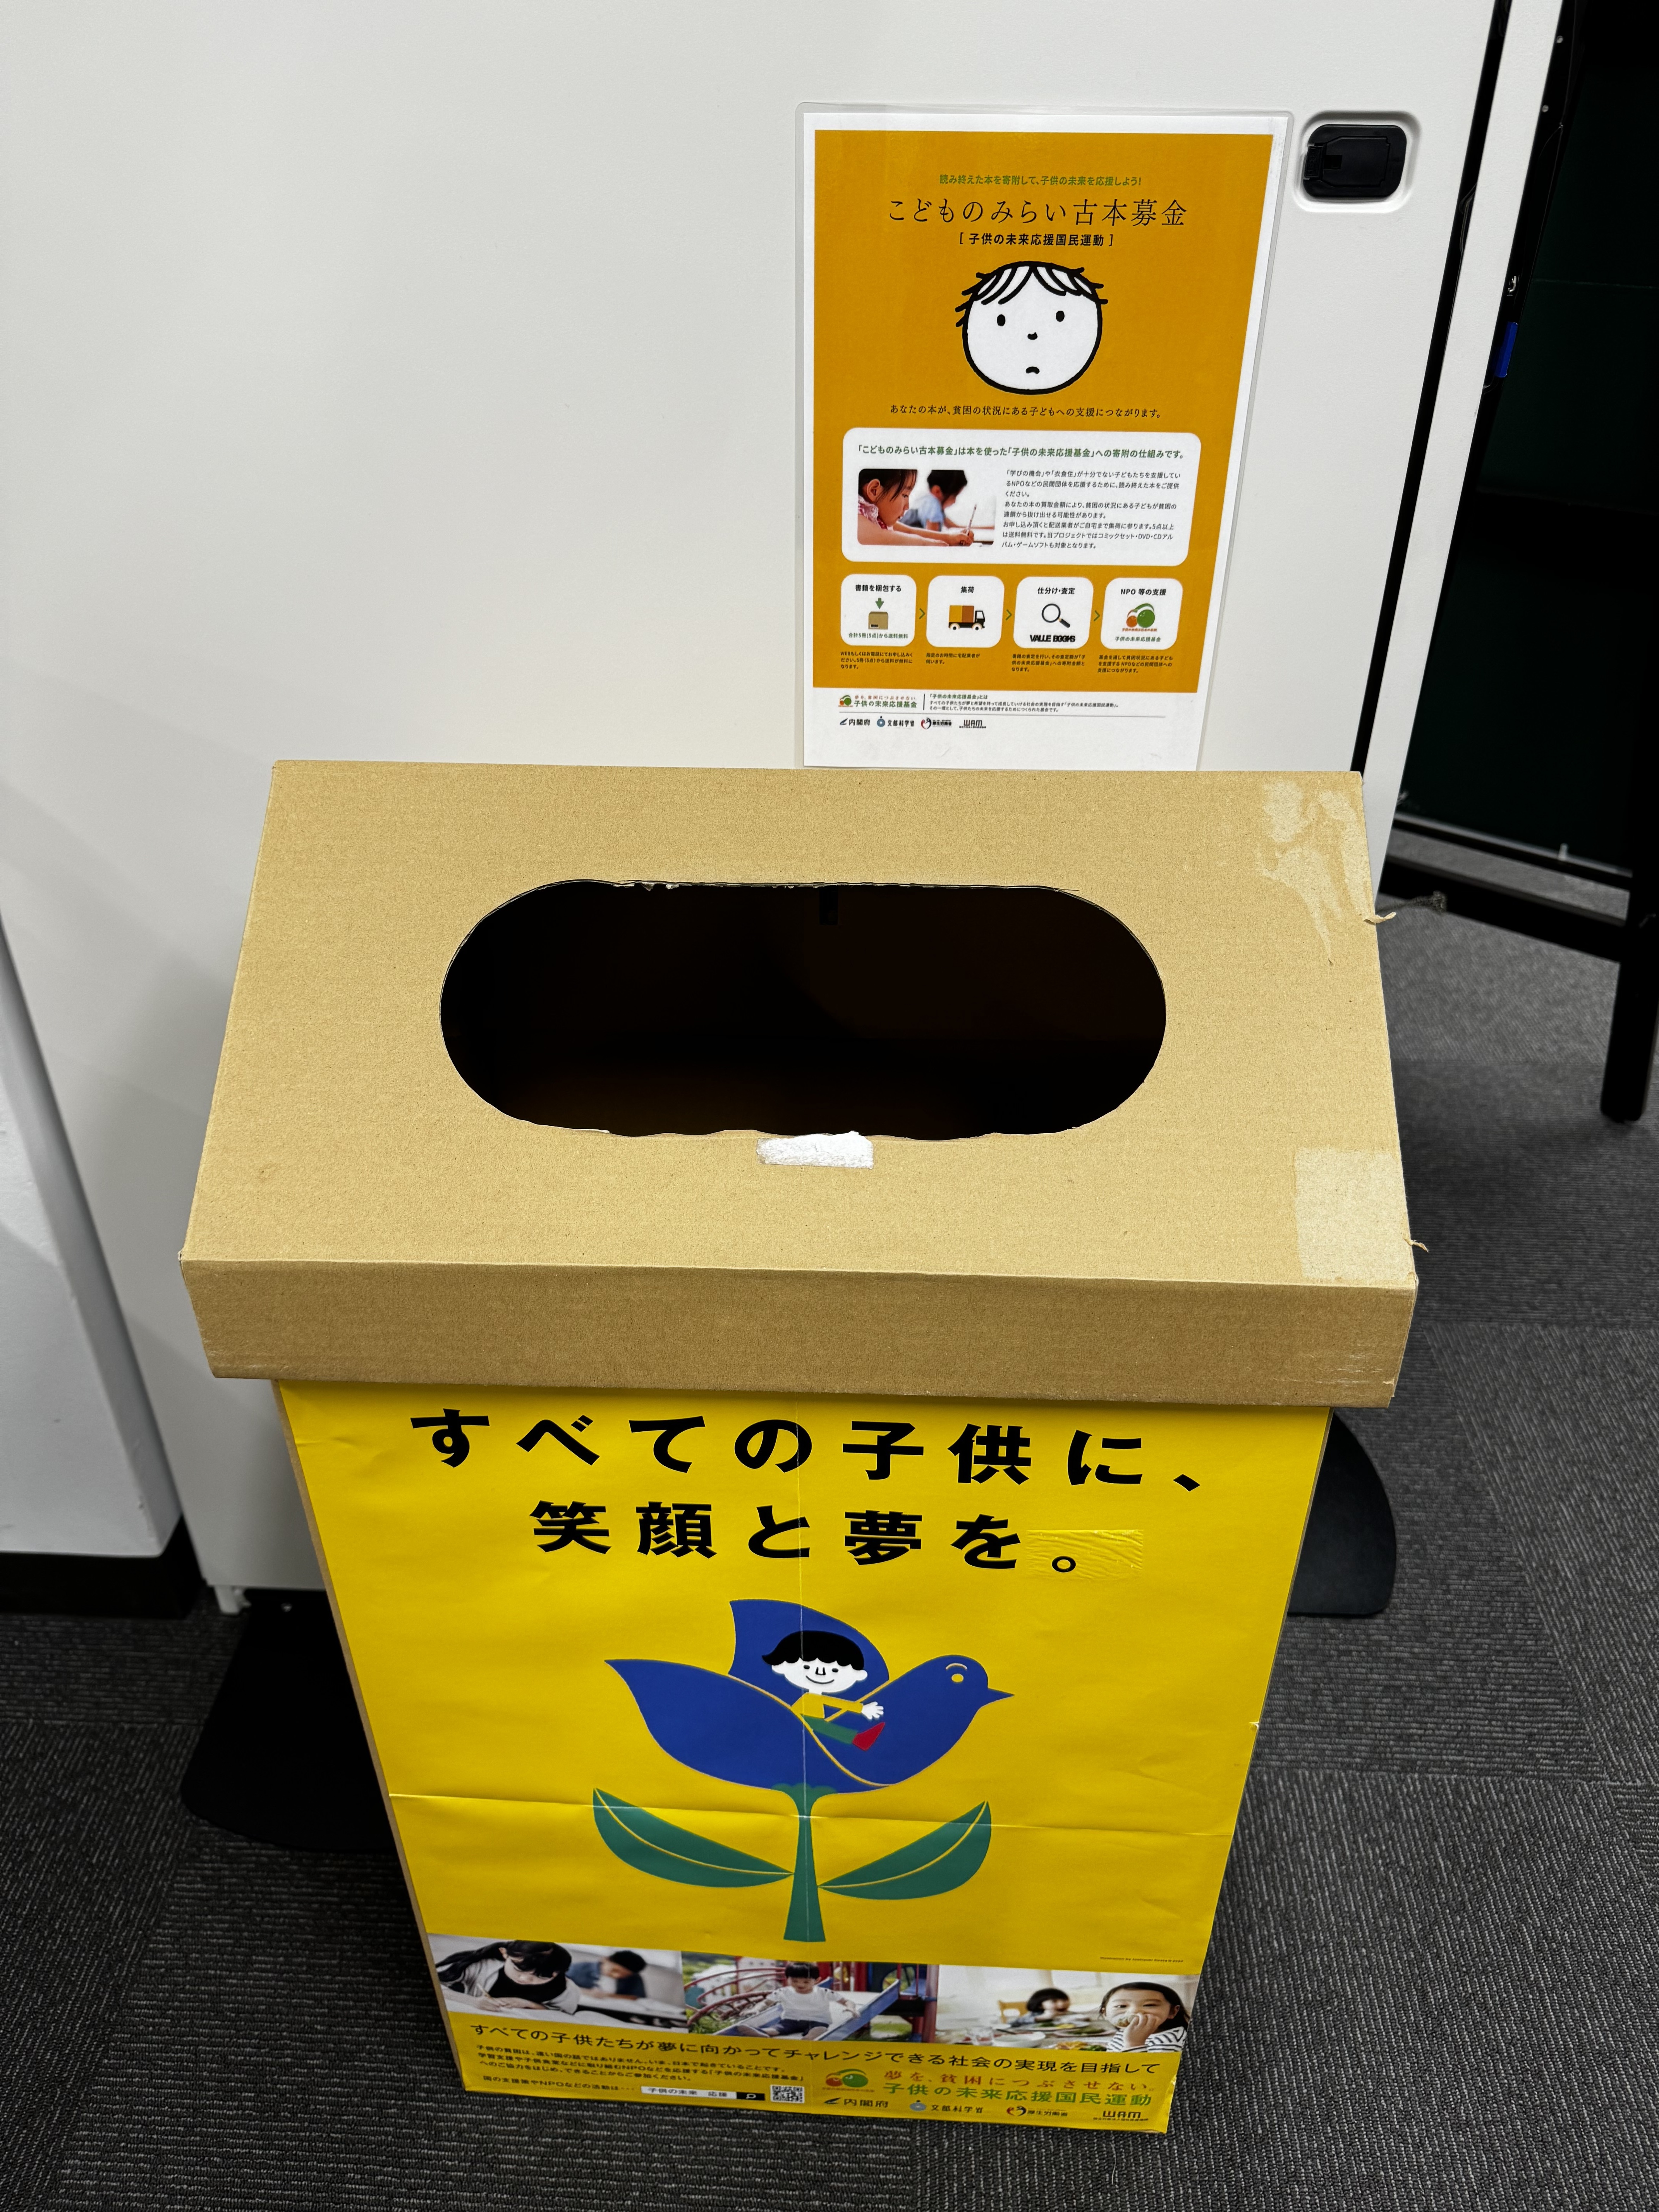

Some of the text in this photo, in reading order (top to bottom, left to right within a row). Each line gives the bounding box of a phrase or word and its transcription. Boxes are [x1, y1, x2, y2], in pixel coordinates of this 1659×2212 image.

[888, 198, 1187, 226] こどものみらい古本募金
[890, 404, 1161, 419] あなたの本が、貧困の状況にある子どもへの支援につながります。
[859, 445, 1183, 459] 「こどものみらい古本募金」は本を使った「子供の未来応援基金」への寄附の仕組みです。
[854, 700, 917, 708] 子供の未来応援基金
[410, 1408, 1201, 1493] すべての子供に、
[531, 1499, 1077, 1574] 笑顔と夢を。
[470, 2024, 1160, 2073] すべての子供たちが夢に向かってチャレンジできる社会の実現を目指して
[883, 2083, 1151, 2106] 子供の未来応援国民運動
